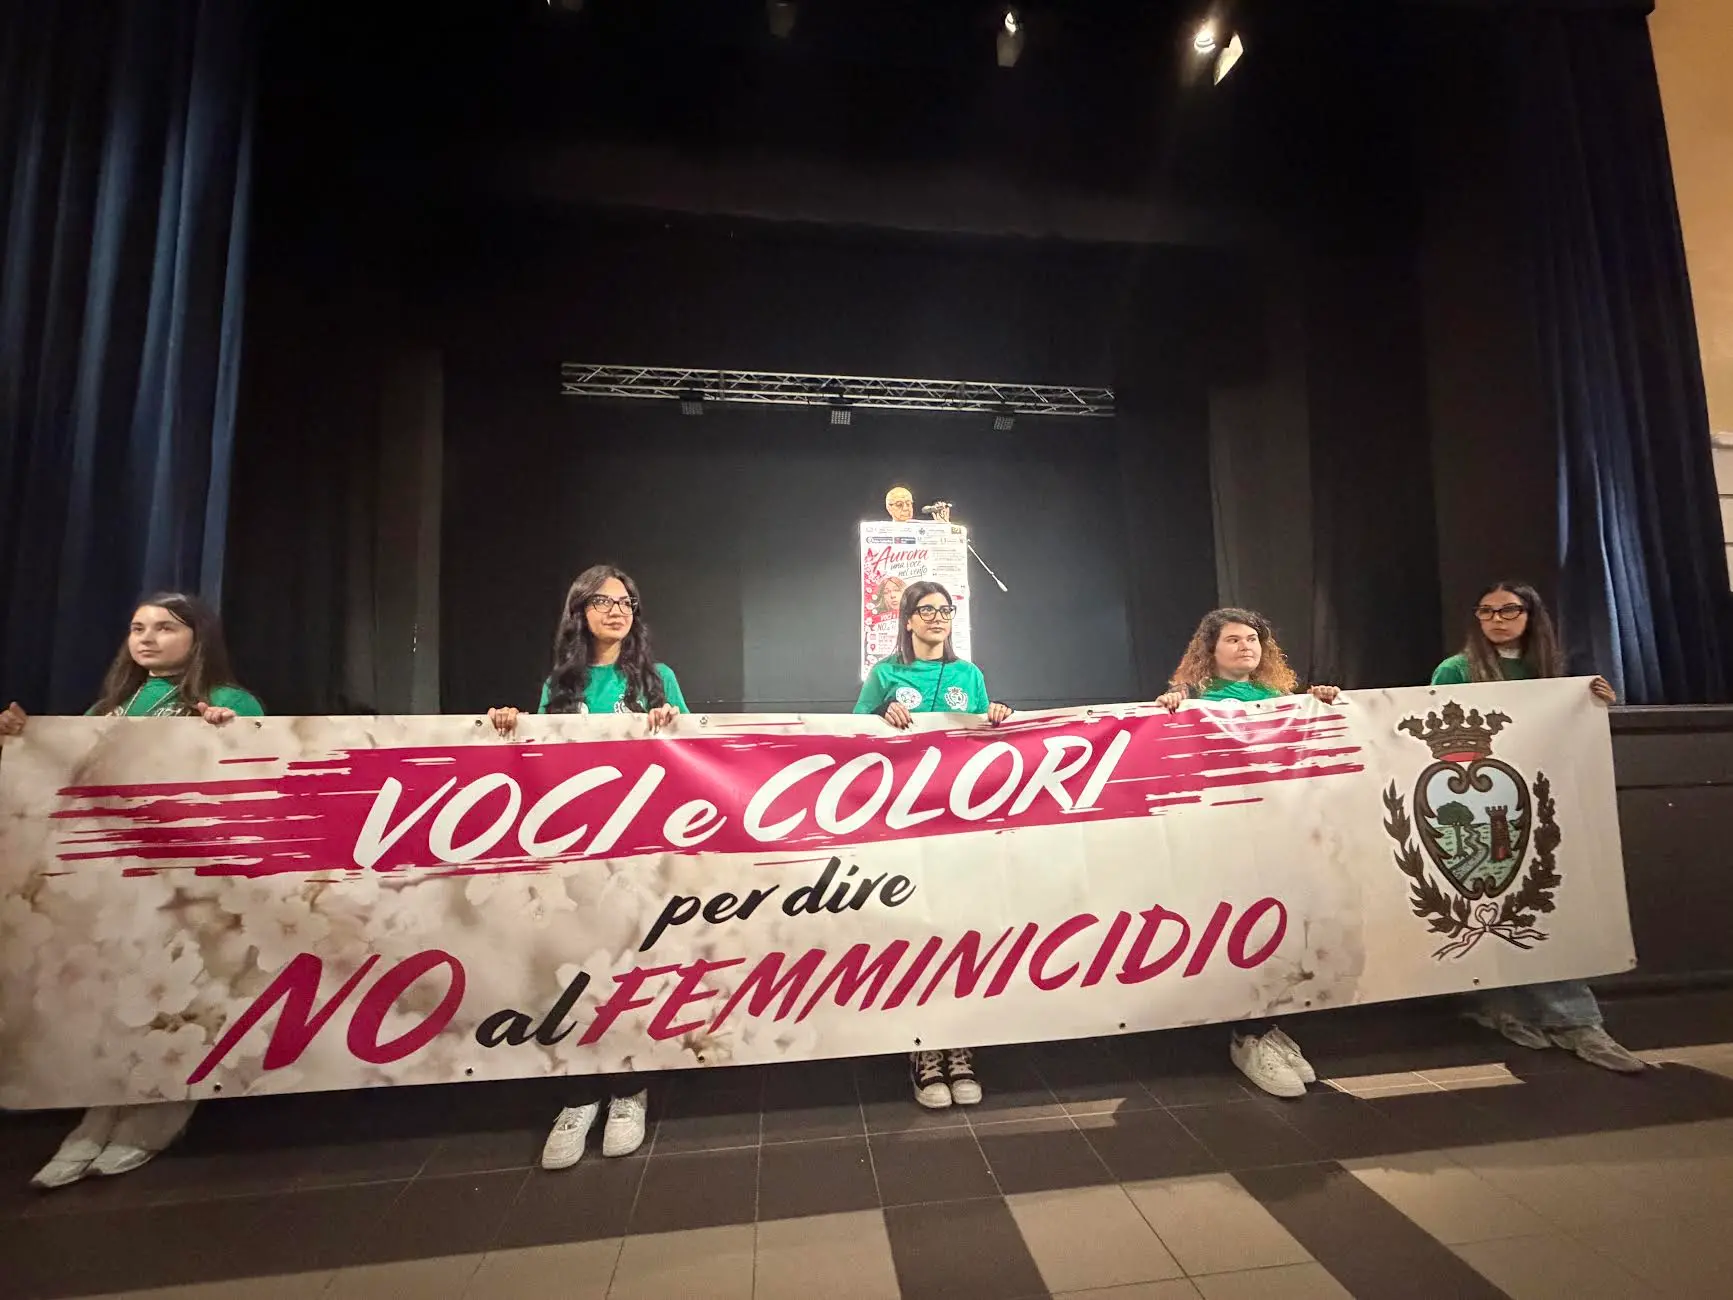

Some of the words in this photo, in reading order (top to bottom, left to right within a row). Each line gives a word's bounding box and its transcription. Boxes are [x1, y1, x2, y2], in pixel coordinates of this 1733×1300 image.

[872, 545, 929, 573] Aurora
[353, 763, 666, 868] VOCI
[662, 799, 727, 847] e
[743, 729, 1131, 842] COLORI
[638, 884, 780, 952] per
[782, 856, 917, 917] dire
[186, 949, 466, 1085] NO
[475, 971, 591, 1048] al
[577, 897, 1287, 1046] FEMMINICIDIO
